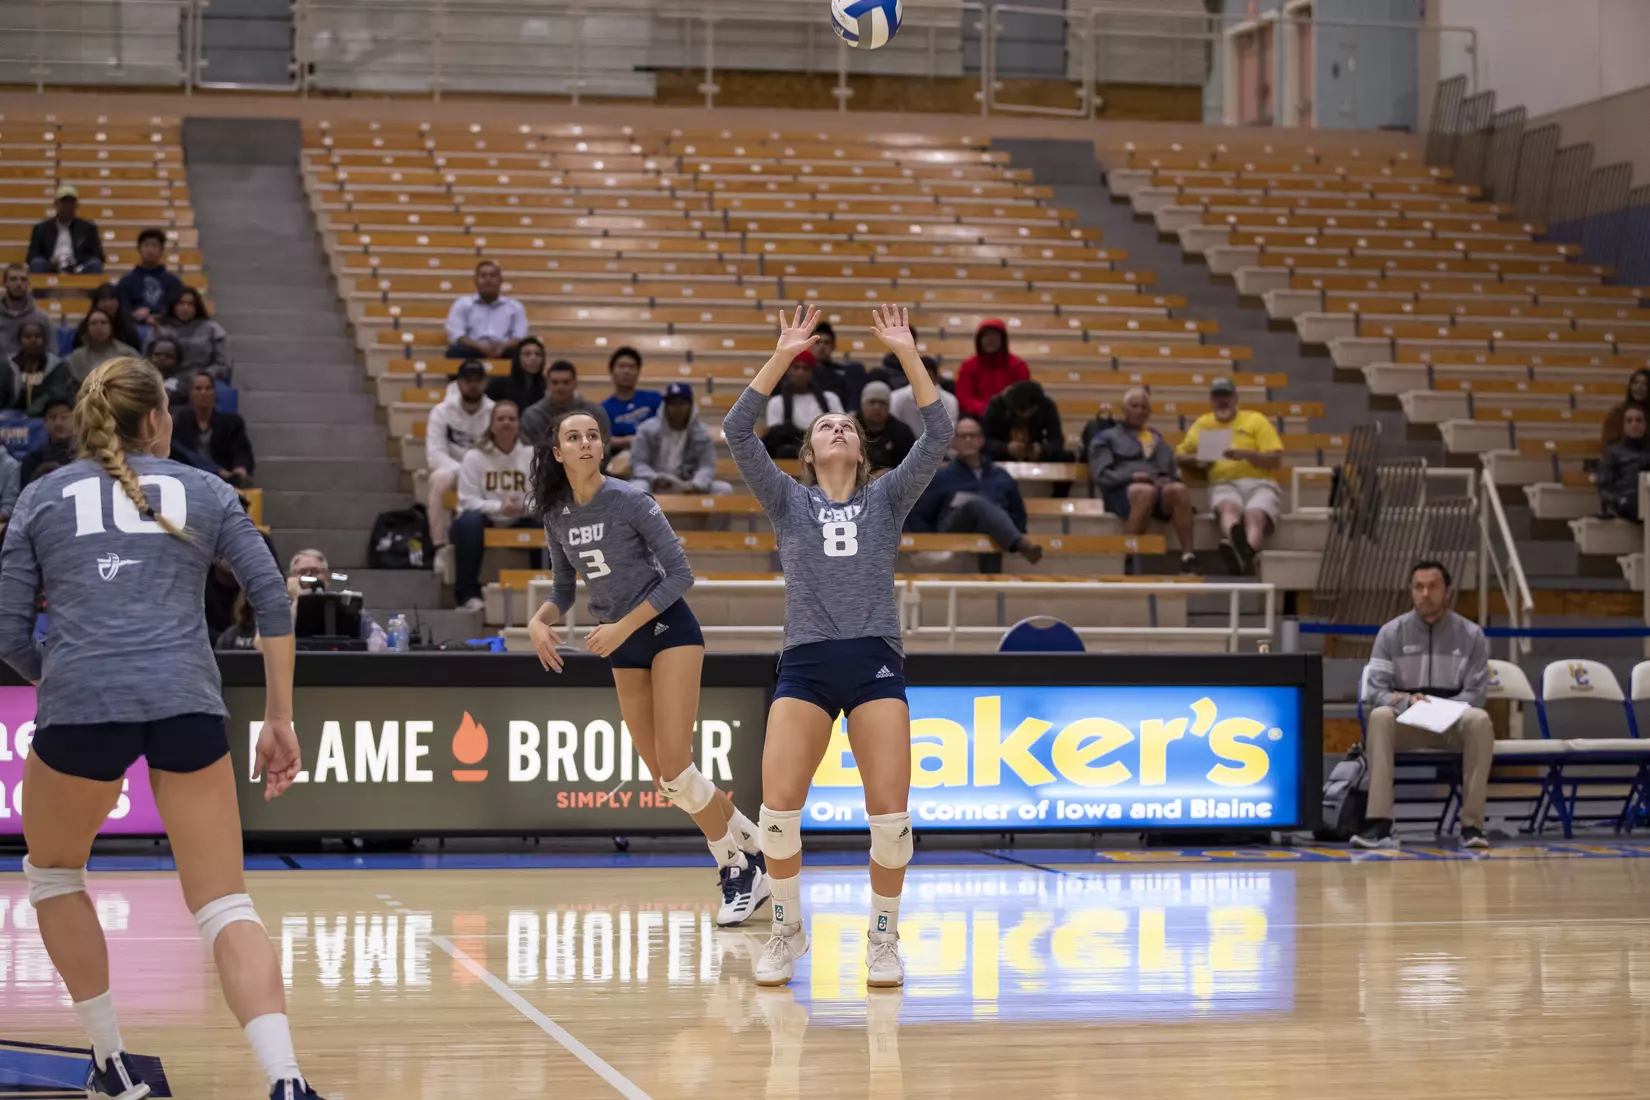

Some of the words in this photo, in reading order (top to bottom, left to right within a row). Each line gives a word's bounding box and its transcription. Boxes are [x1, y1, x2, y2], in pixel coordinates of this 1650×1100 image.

[486, 470, 526, 492] UCR
[62, 474, 187, 537] 10
[567, 522, 605, 546] CBU
[822, 521, 858, 557] 8
[578, 548, 612, 580] 3
[249, 720, 434, 783] AME
[508, 719, 734, 782] BROIR
[556, 791, 633, 809] SIMPLY
[810, 801, 852, 822] On
[918, 800, 1011, 821] Corner
[1018, 799, 1049, 821] of
[1056, 800, 1122, 820] Iowa
[1129, 799, 1182, 820] and
[1190, 798, 1272, 820] Blaine
